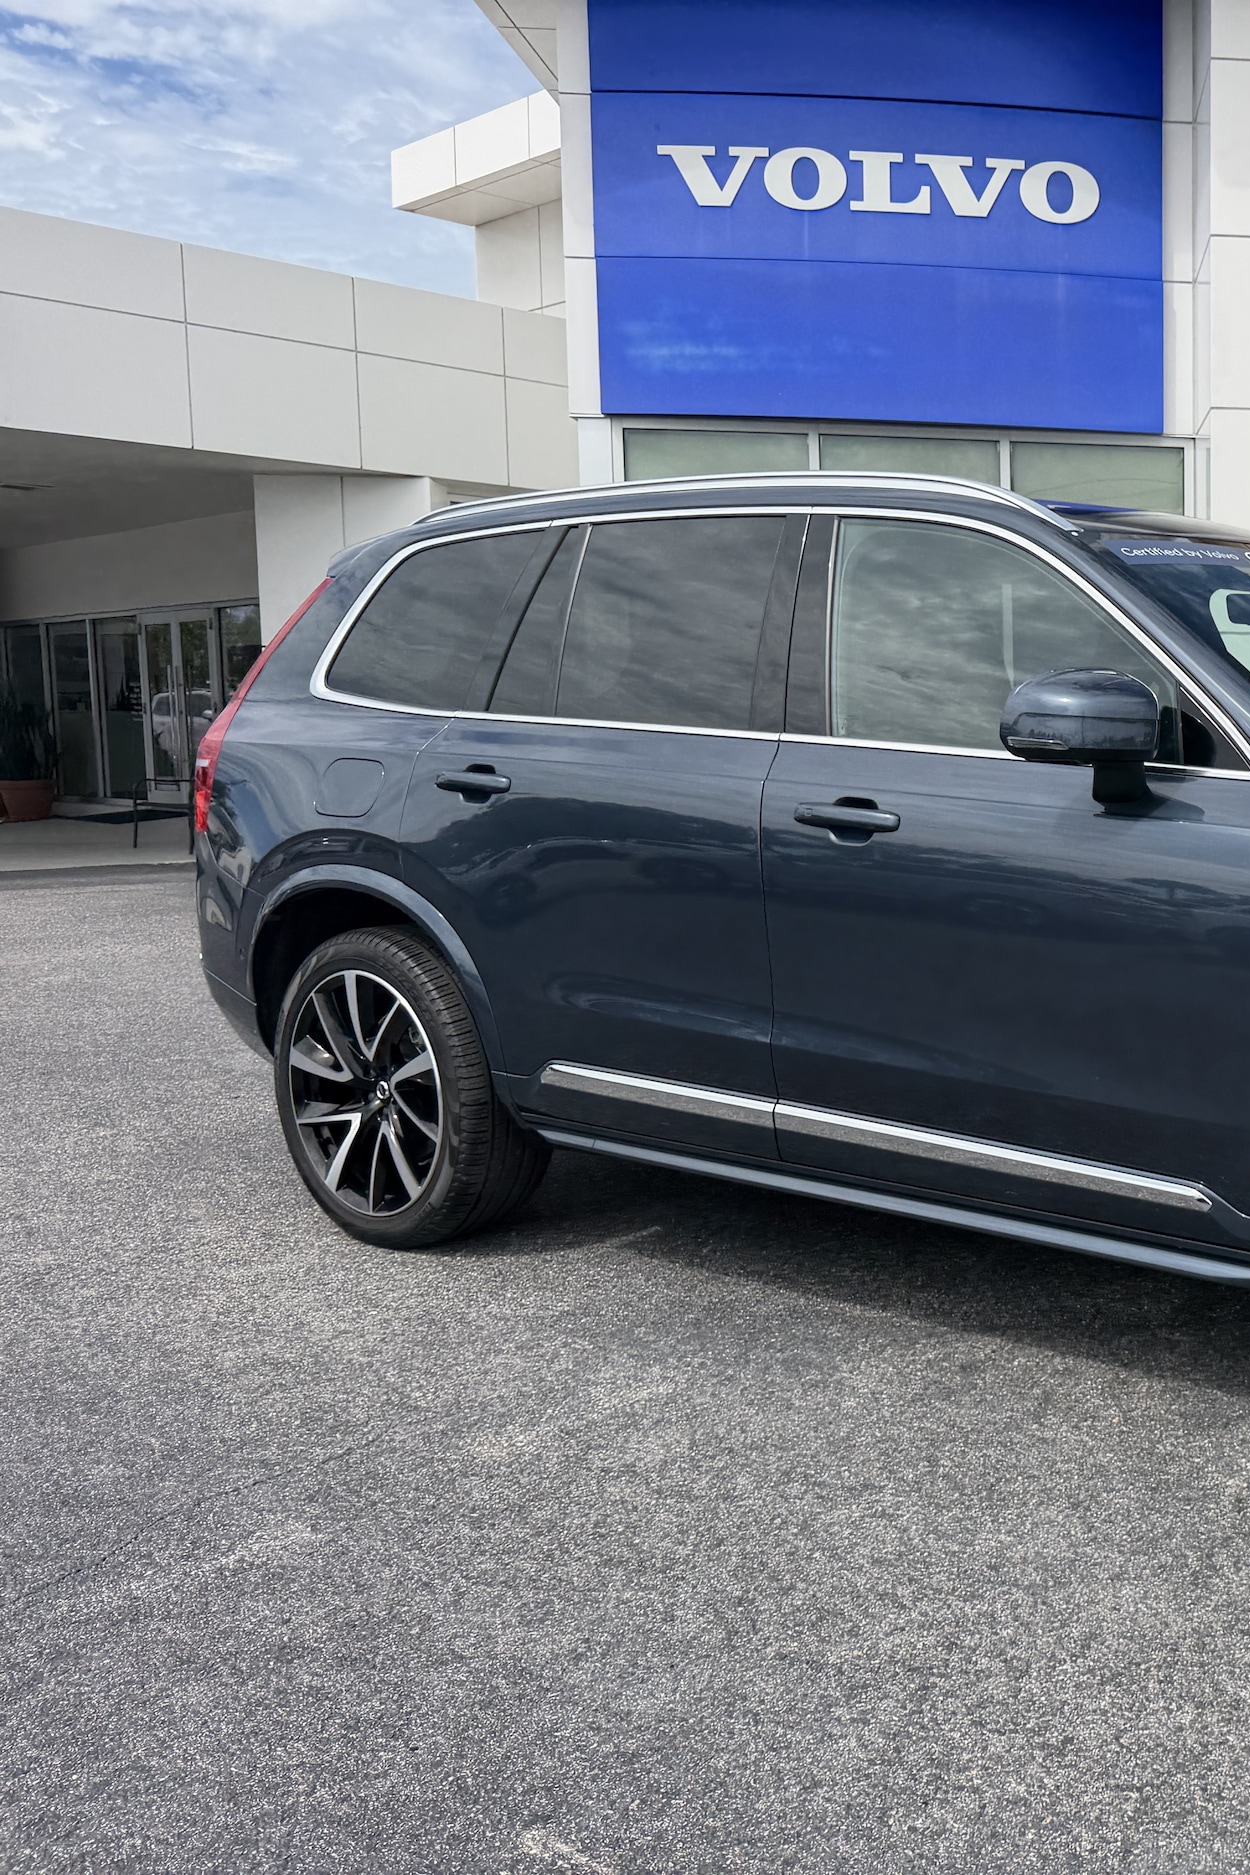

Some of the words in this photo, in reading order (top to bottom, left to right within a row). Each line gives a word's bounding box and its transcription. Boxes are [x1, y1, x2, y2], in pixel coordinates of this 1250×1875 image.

[657, 144, 1100, 224] VOLVO
[1120, 546, 1183, 557] Certified
[1181, 547, 1202, 559] by
[1200, 549, 1240, 561] Volvo
